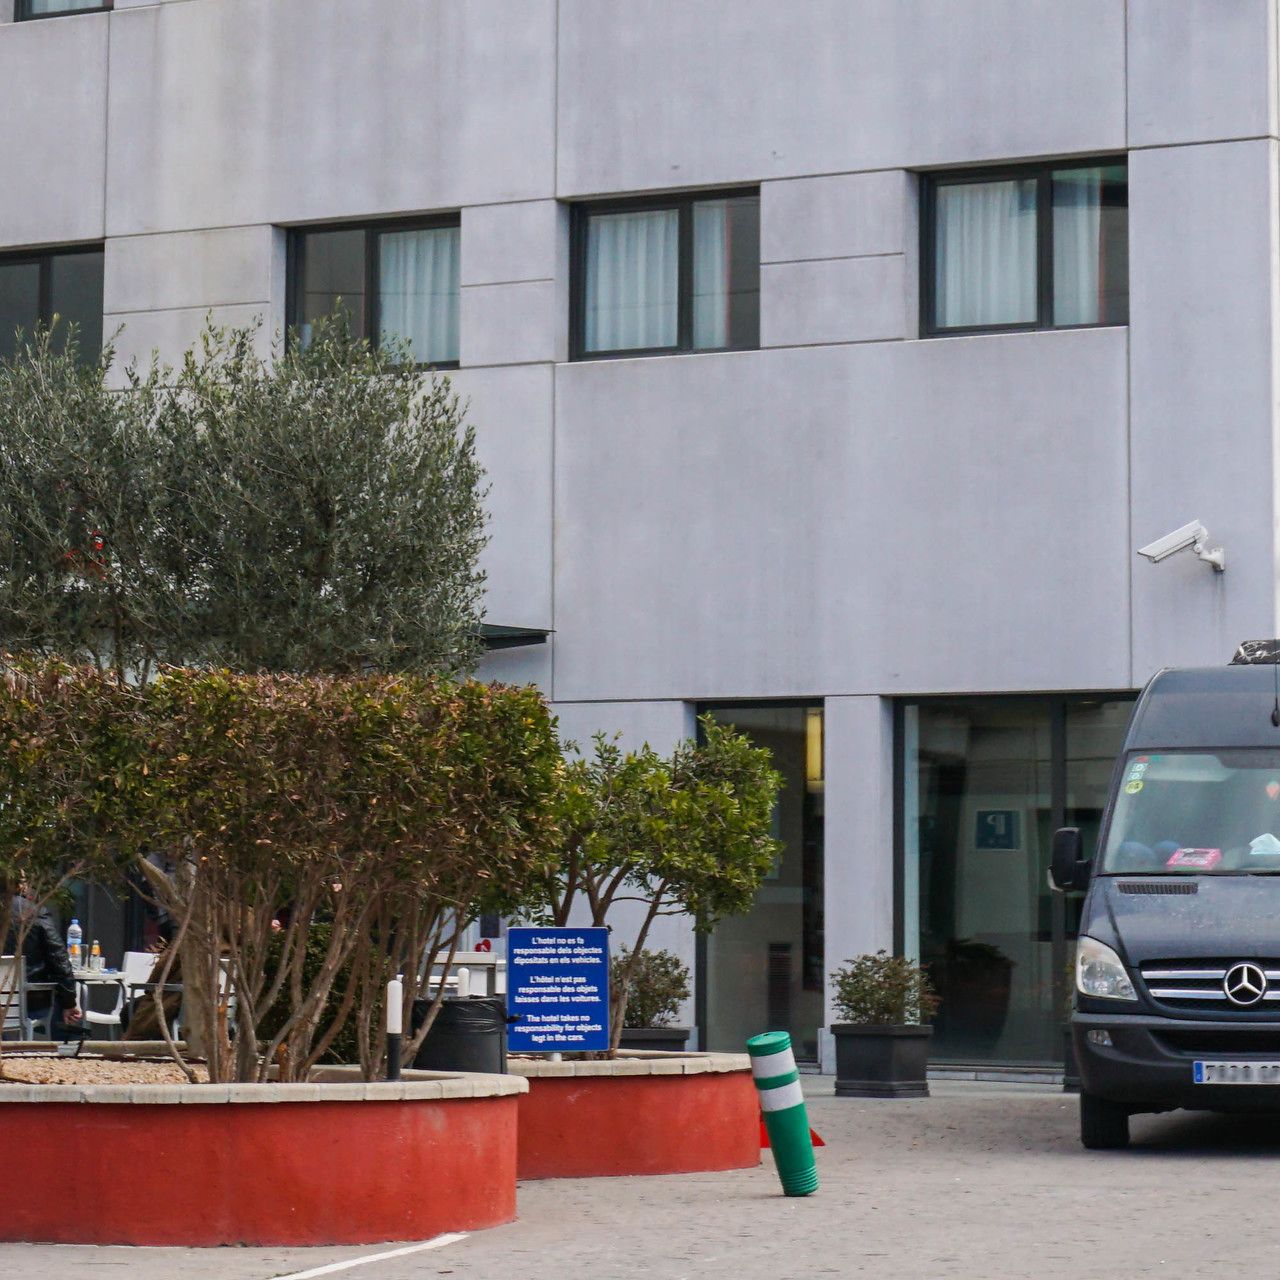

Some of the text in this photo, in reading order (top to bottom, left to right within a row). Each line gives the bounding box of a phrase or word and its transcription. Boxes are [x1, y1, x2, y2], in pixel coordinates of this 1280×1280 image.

[513, 946, 556, 956] responsable
[518, 985, 561, 994] responsable
[526, 1014, 540, 1022] The
[541, 1014, 560, 1022] hotel
